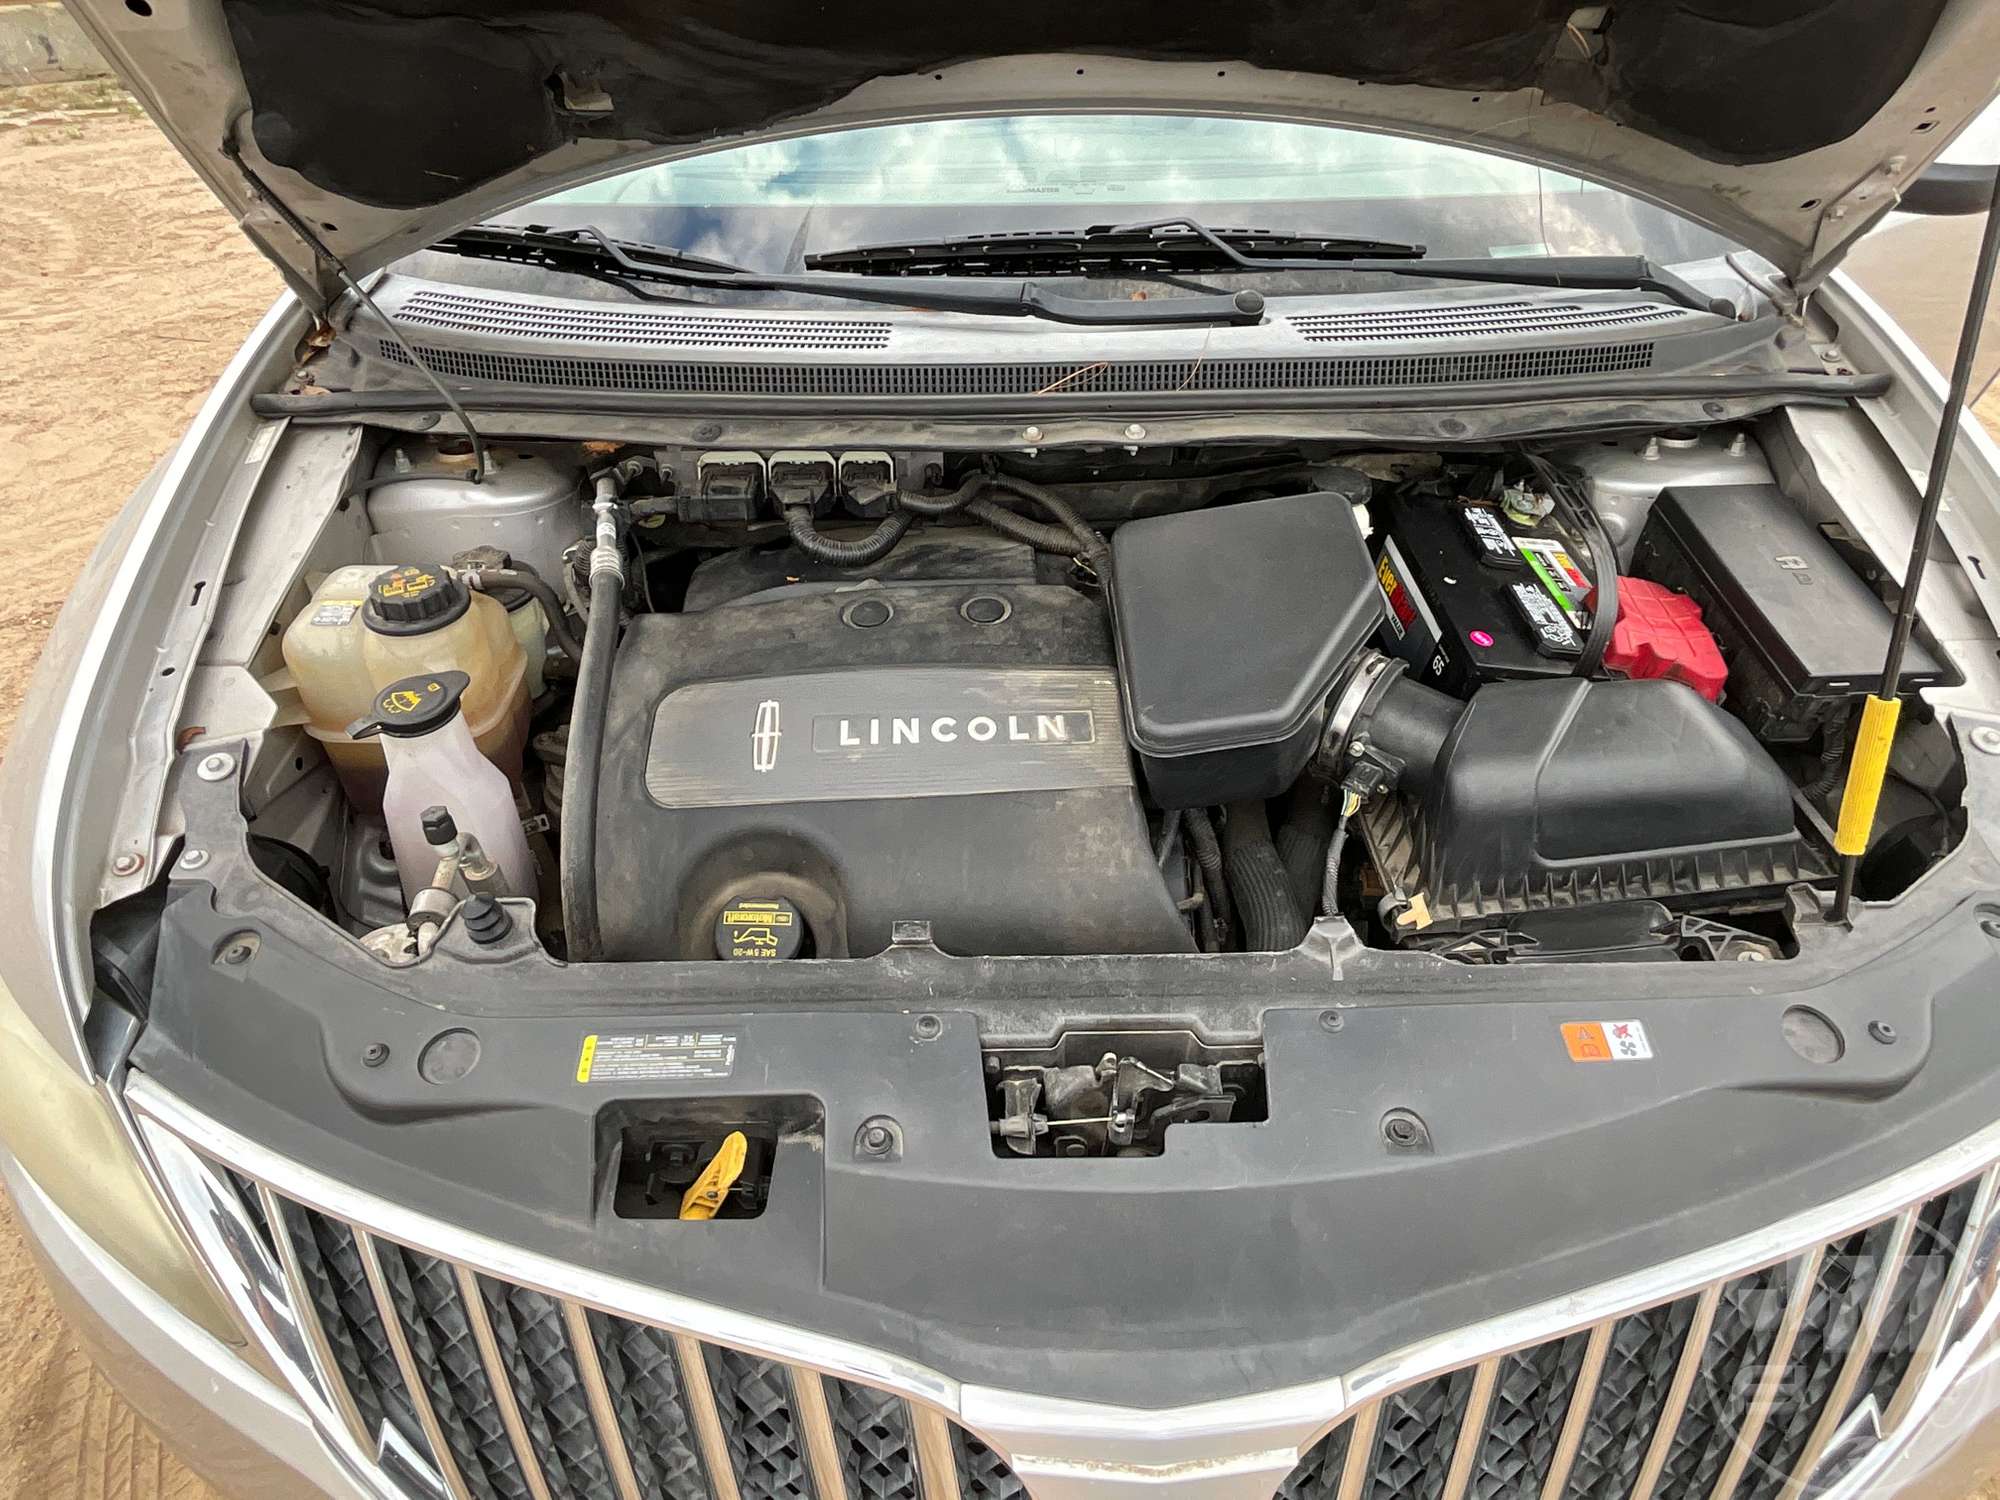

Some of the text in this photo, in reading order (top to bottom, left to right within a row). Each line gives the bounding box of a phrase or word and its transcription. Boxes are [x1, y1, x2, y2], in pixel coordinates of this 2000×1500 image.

[1432, 655, 1445, 676] 65
[839, 714, 1067, 746] LINCOLN
[760, 948, 777, 957] SAE
